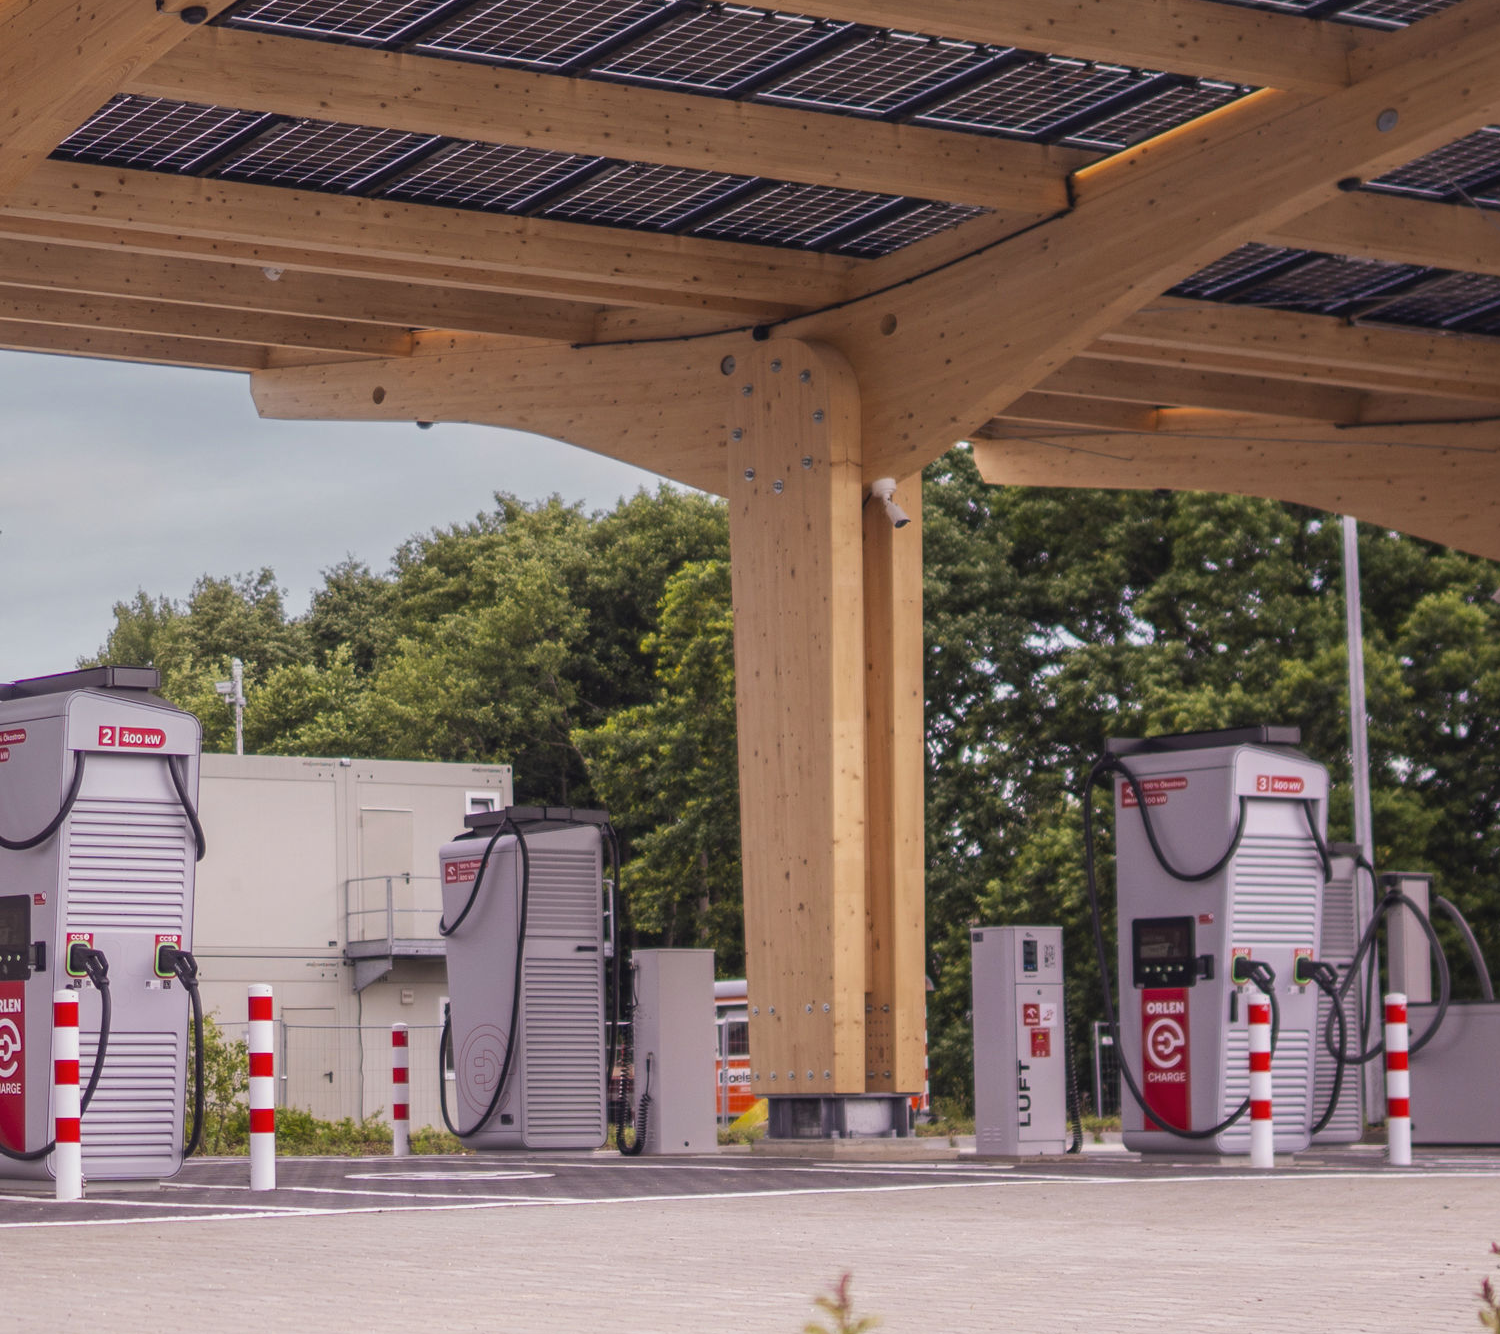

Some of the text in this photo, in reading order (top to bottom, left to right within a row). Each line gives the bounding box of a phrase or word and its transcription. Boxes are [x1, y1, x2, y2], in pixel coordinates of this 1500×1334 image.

[102, 728, 162, 745] 2 400 kW
[1258, 777, 1267, 790] 3
[1147, 1002, 1185, 1014] ORLEN
[1148, 1072, 1187, 1083] CHARGE
[1018, 1059, 1032, 1127] LUFT
